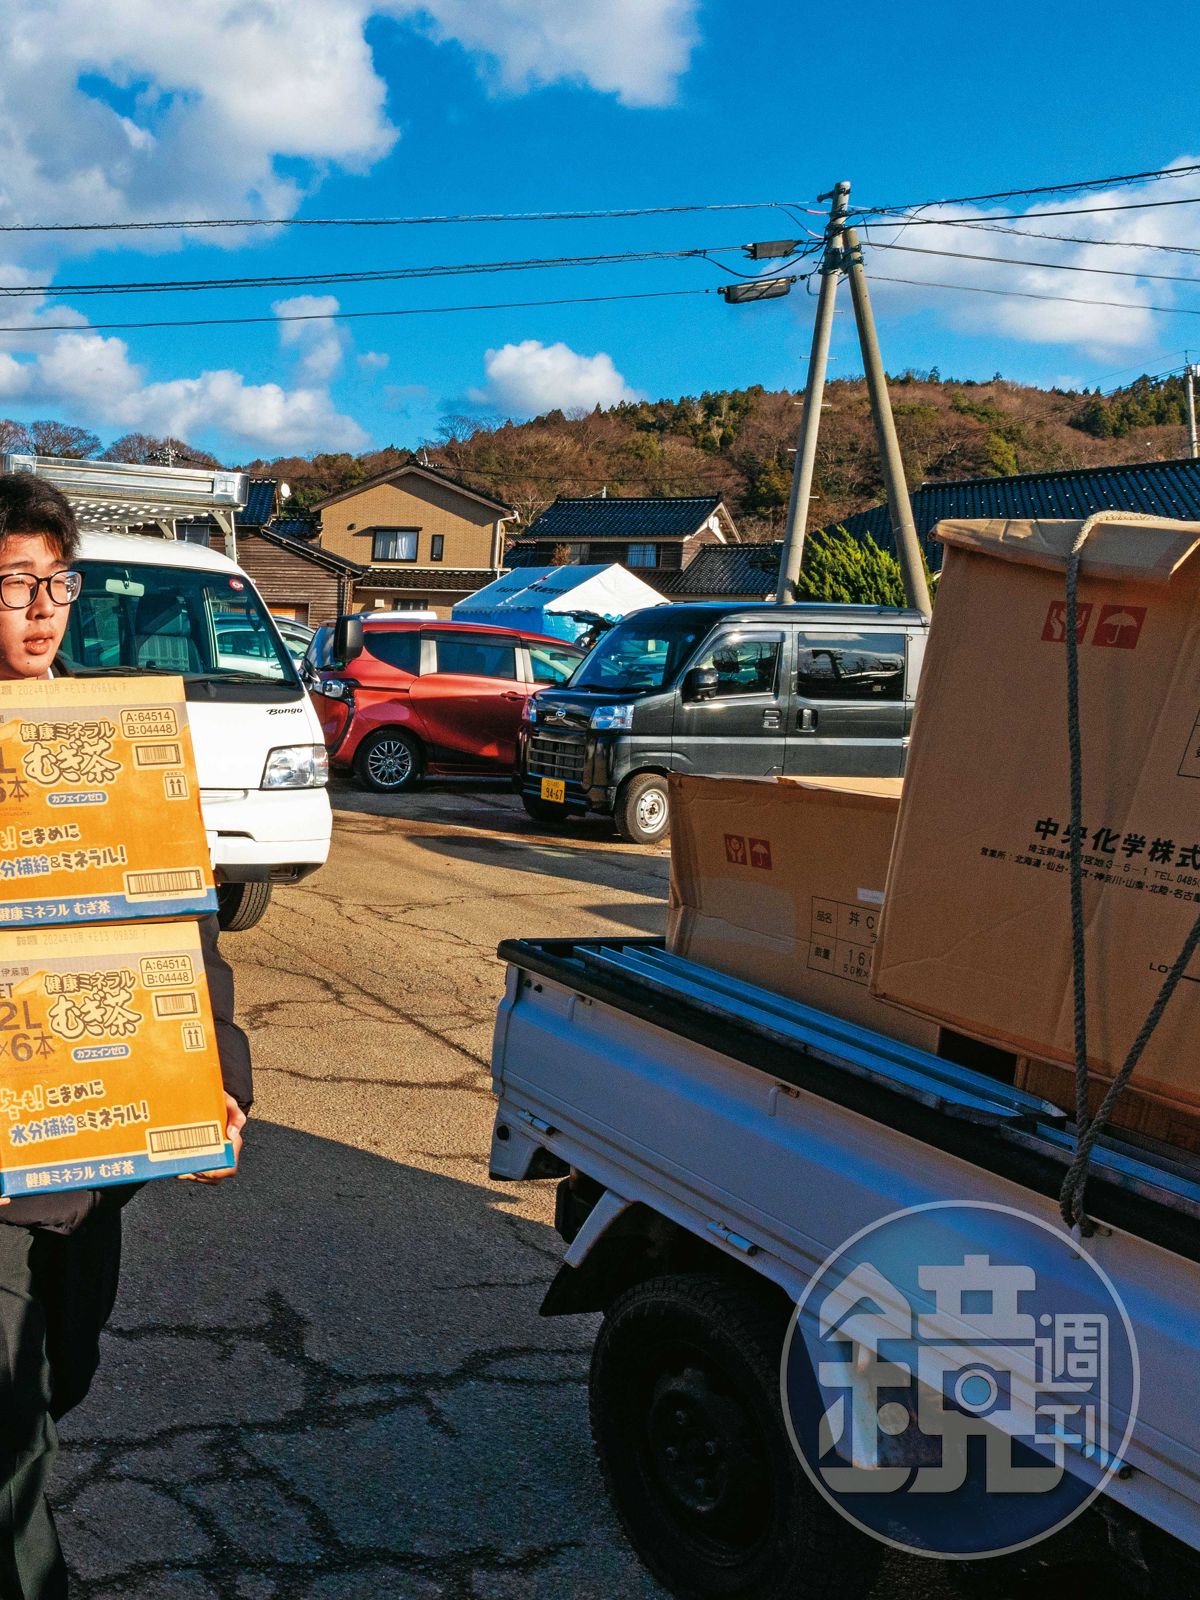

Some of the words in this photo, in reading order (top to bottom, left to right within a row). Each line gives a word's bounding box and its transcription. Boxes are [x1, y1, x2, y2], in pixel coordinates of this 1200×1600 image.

[126, 711, 171, 722] A:64514
[20, 721, 115, 743] 健康ミネラル
[128, 724, 173, 735] B:04448
[24, 739, 122, 784] むぎ茶
[52, 793, 103, 804] カフェインゼロ
[1154, 871, 1173, 882] TEL
[74, 901, 111, 914] むぎ茶
[145, 960, 187, 971] A:64514
[1, 967, 30, 977] 伊藤園
[44, 971, 136, 994] 健康ミネラル
[147, 974, 189, 984] B:04448
[49, 989, 142, 1039] むぎ茶
[76, 1047, 126, 1059] カフェインゼロ
[99, 1161, 135, 1177] むぎ茶
